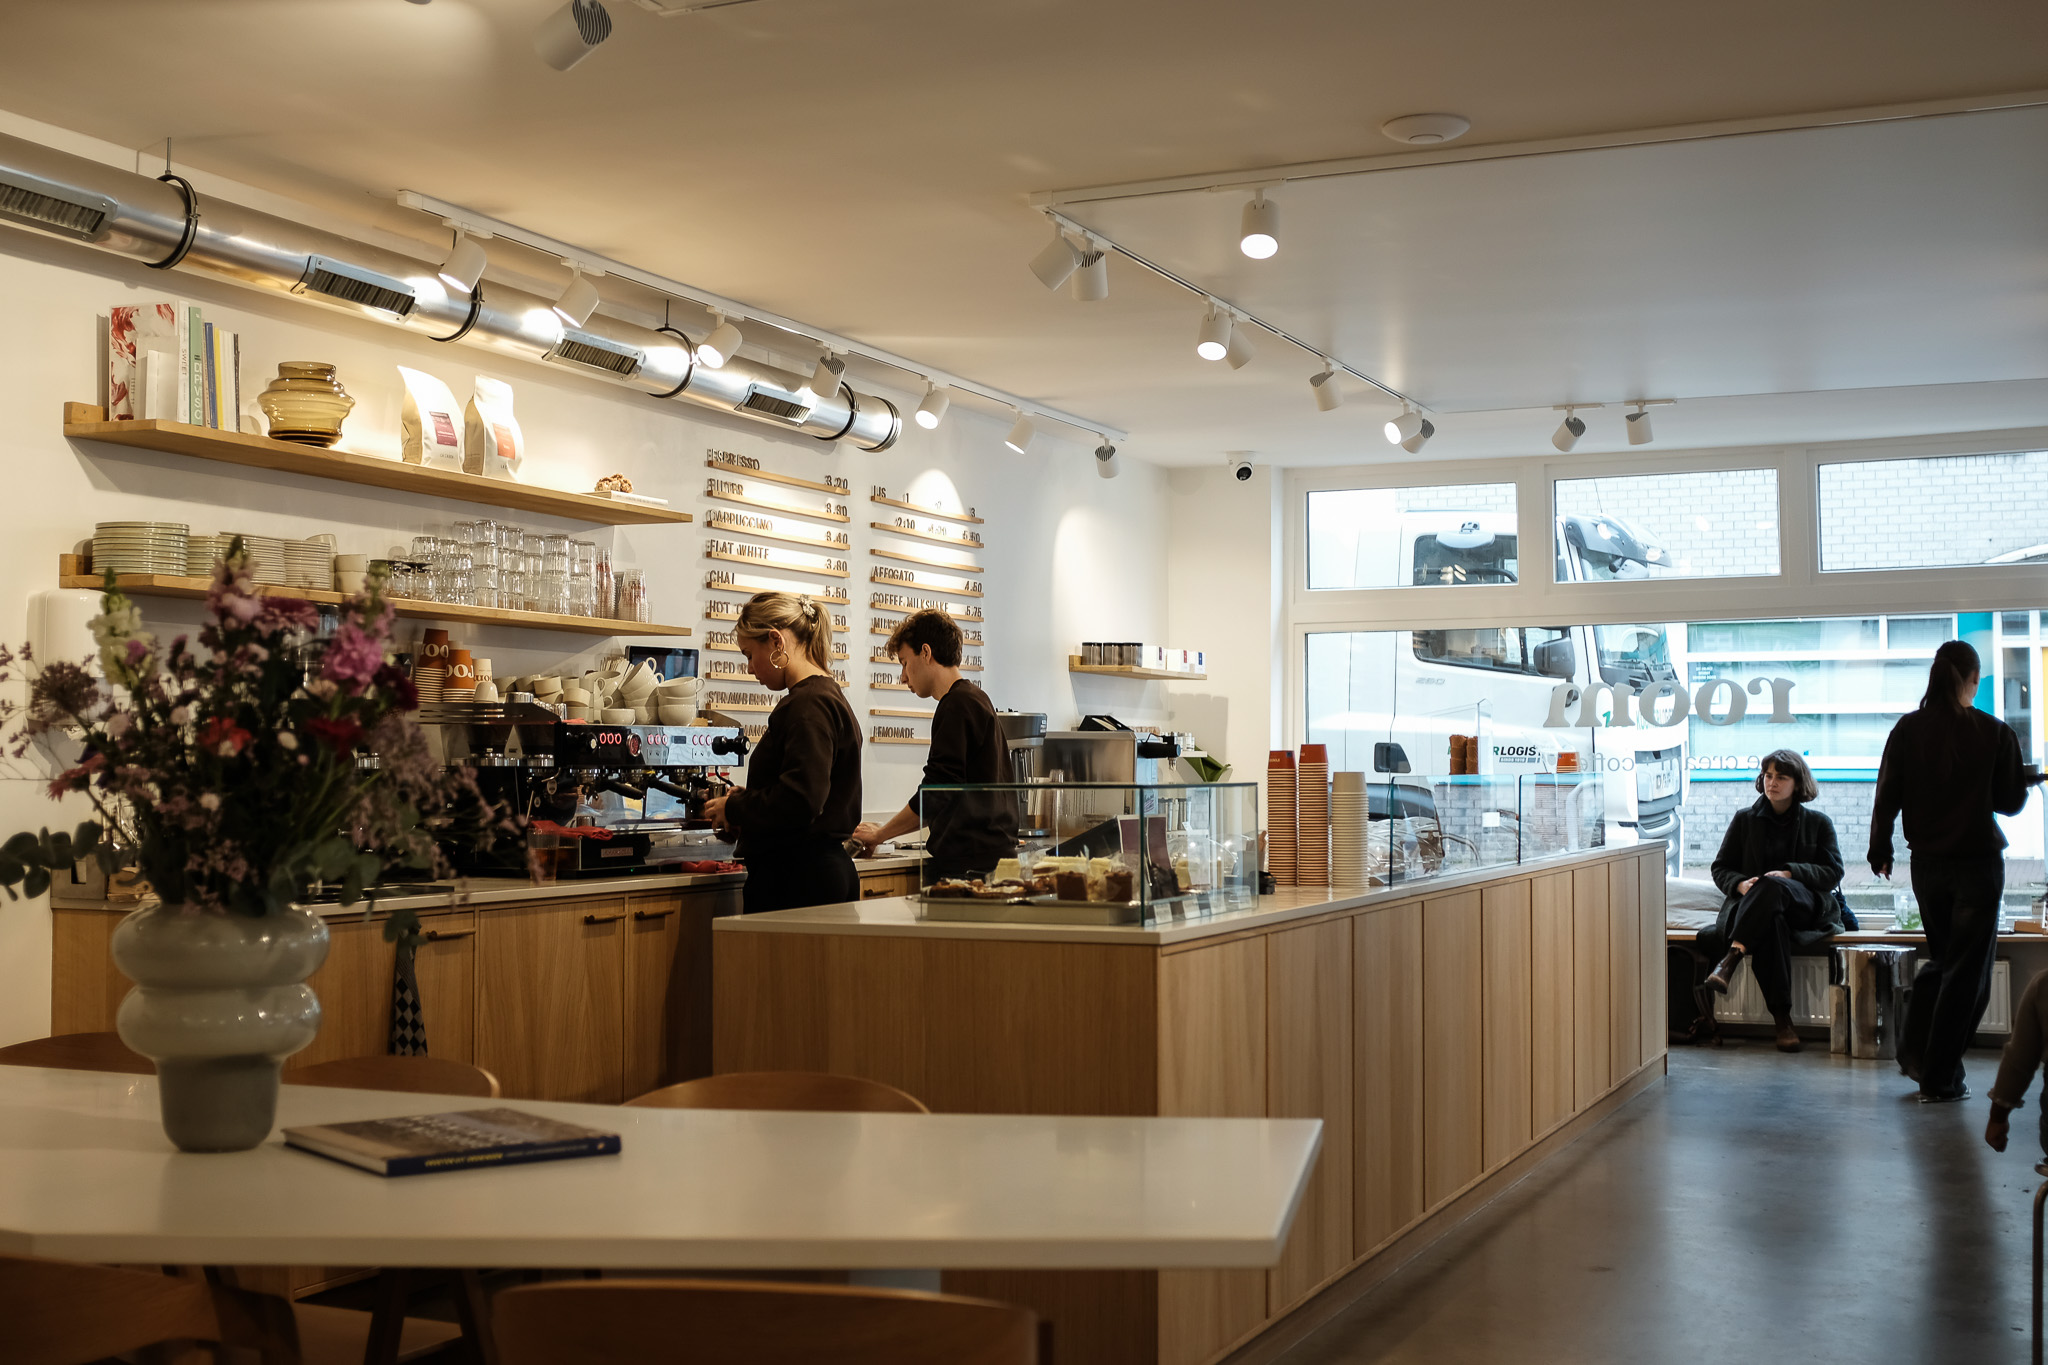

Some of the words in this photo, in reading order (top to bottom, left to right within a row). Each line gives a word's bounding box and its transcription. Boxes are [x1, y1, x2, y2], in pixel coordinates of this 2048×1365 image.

[710, 448, 761, 471] ESPRESSO
[709, 478, 744, 496] FILTER
[709, 509, 773, 531] CAPPUCCINO
[970, 507, 976, 518] 3
[710, 539, 734, 555] FLAT
[738, 544, 769, 559] WHITE
[873, 565, 915, 582] AFFOGATO
[709, 570, 735, 585] CHAI
[825, 585, 847, 599] 5.50
[709, 600, 731, 614] HOT
[872, 591, 904, 607] COFFEE
[906, 596, 949, 613] MILKSHAKE
[832, 642, 847, 654] .50
[709, 660, 736, 674] ICED
[873, 672, 893, 685] ICED
[708, 690, 774, 707] STRAWBERRY
[873, 725, 915, 739] LEMONADE
